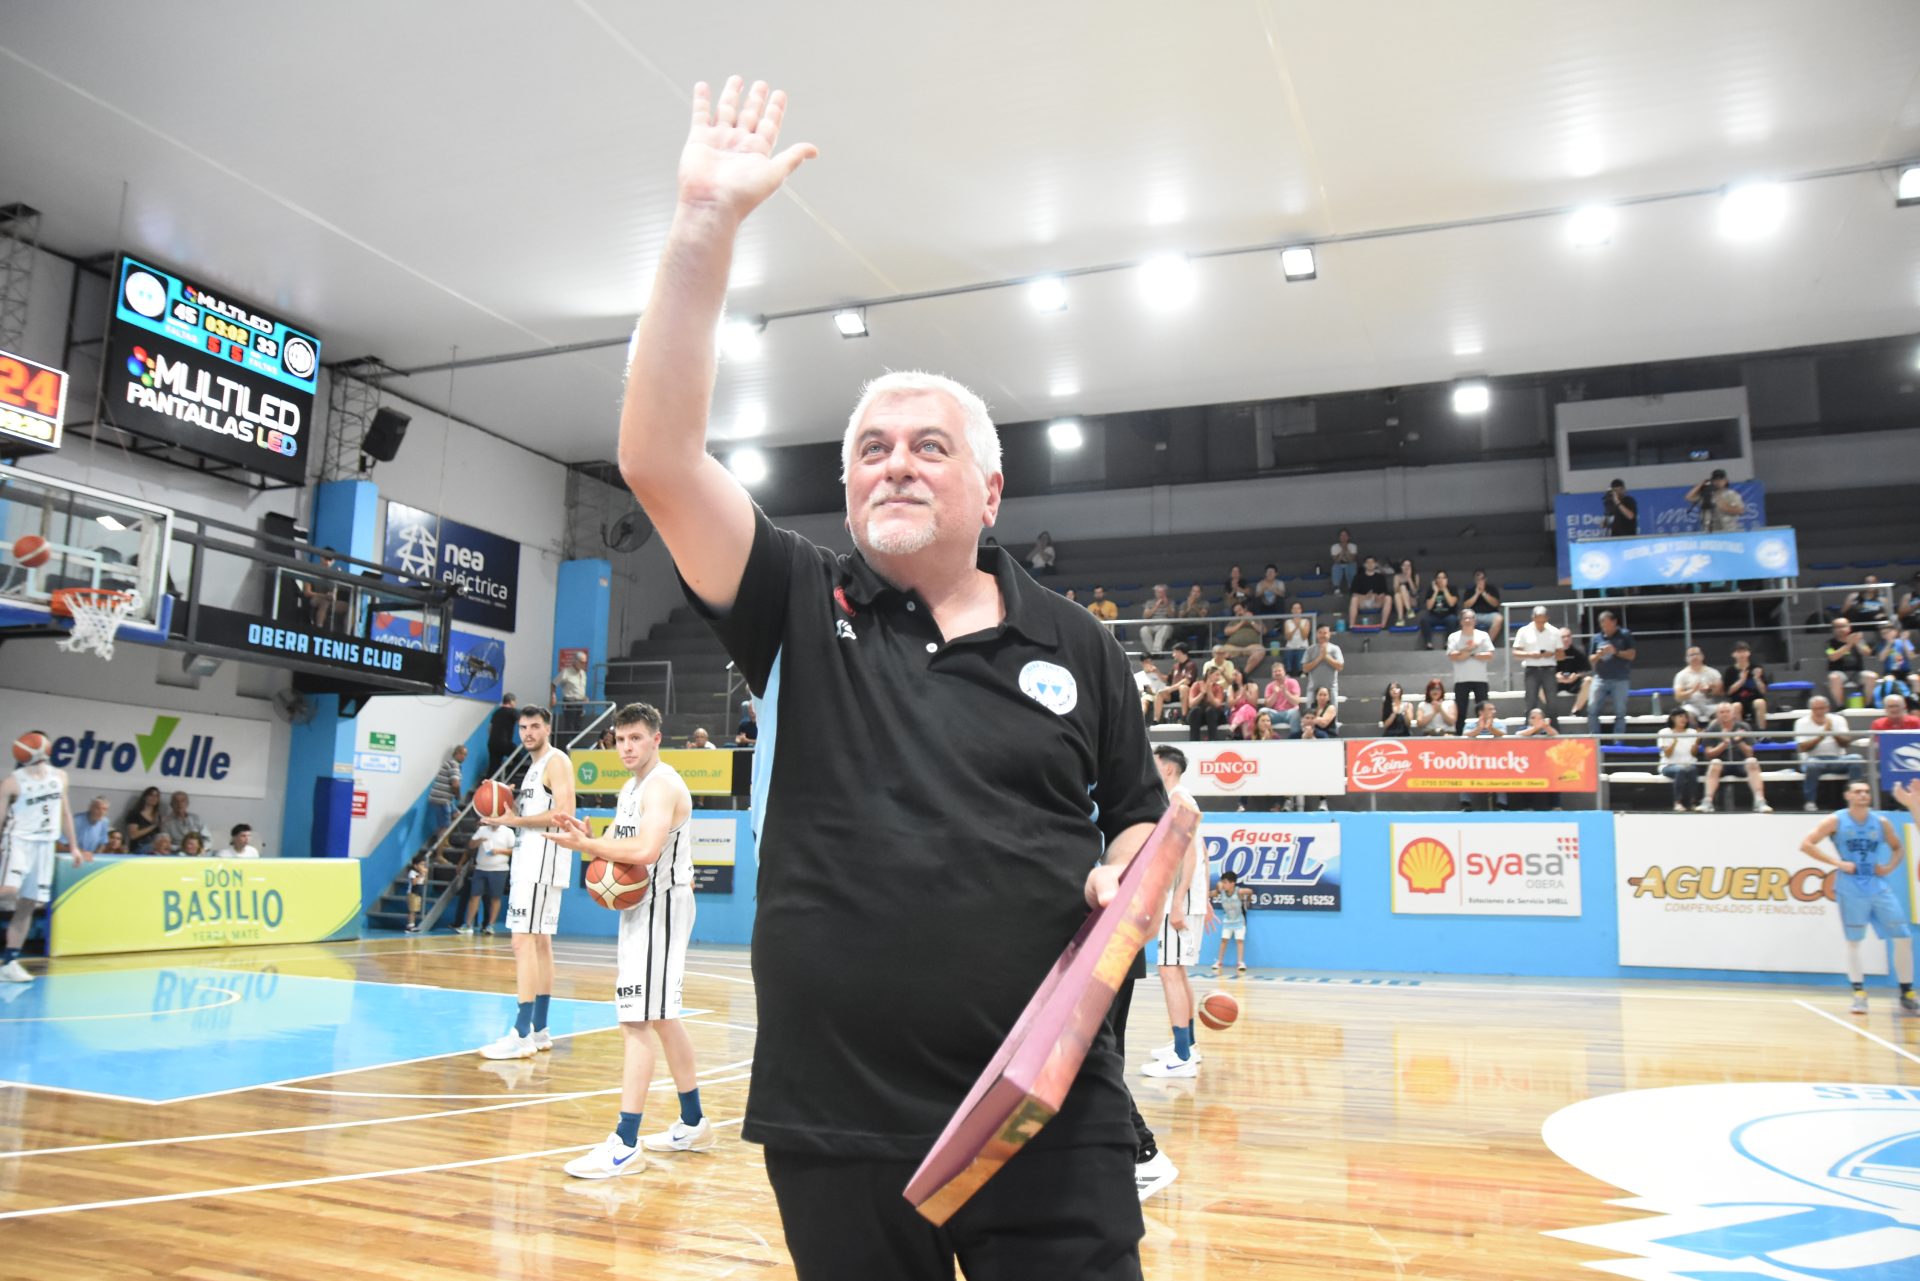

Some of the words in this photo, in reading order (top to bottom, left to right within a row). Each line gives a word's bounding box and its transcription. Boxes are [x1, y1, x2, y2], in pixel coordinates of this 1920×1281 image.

[173, 303, 198, 325] 45
[197, 291, 273, 335] MULTILED
[205, 315, 249, 345] 03:02
[208, 338, 220, 353] 5
[231, 348, 243, 363] 5
[0, 356, 59, 416] 24
[155, 353, 301, 436] MULTILED
[127, 381, 254, 442] PANTALLAS
[256, 426, 298, 457] LED
[444, 543, 485, 572] nea
[442, 568, 508, 600] eléctrica
[248, 624, 309, 654] OBERA
[313, 636, 360, 663] TENIS
[362, 648, 403, 672] CLUB
[50, 715, 231, 780] etroValle
[1418, 750, 1530, 773] Foodtrucks
[1202, 761, 1256, 774] DINCO
[1370, 756, 1413, 774] Reina
[1231, 829, 1293, 845] Aguas
[1202, 836, 1324, 881] POHL
[1466, 852, 1564, 885] syasa
[204, 869, 243, 888] DON
[163, 889, 283, 932] BASILIO
[1273, 894, 1296, 904] 3755
[1302, 894, 1335, 906] 615252
[1664, 902, 1754, 914] COMPENSADOS
[232, 928, 260, 940] MATE
